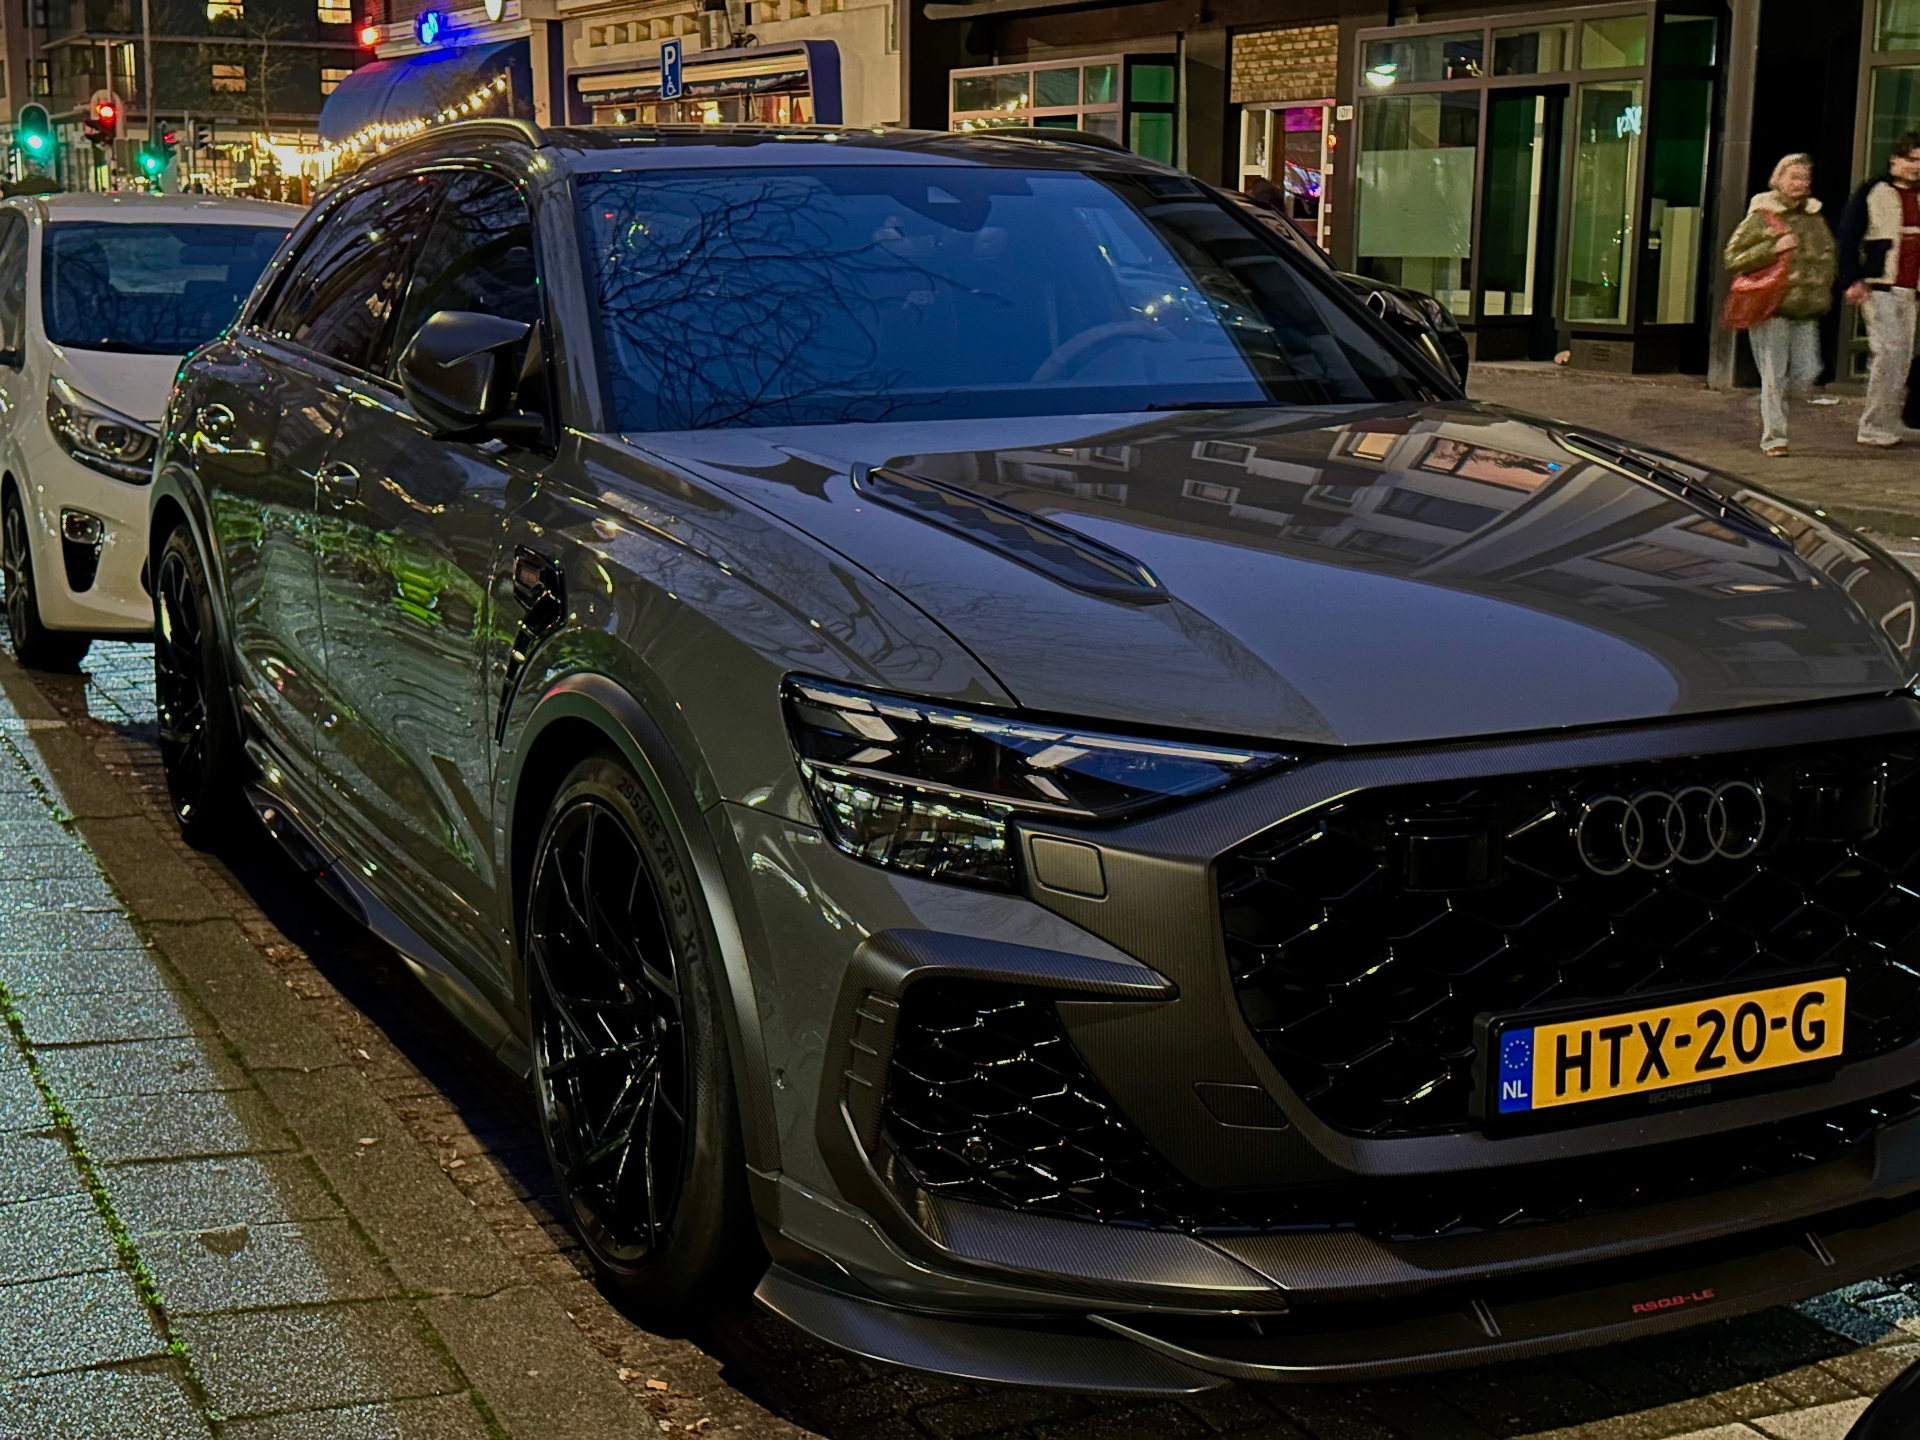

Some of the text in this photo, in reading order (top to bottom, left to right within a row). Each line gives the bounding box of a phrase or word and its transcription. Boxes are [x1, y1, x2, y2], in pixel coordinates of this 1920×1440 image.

[664, 45, 677, 76] P
[615, 776, 700, 970] 295/35 ZR 23 XL
[1555, 991, 1826, 1097] HTX-20-G
[1502, 1079, 1529, 1101] NL
[1648, 1082, 1713, 1104] BORGERS
